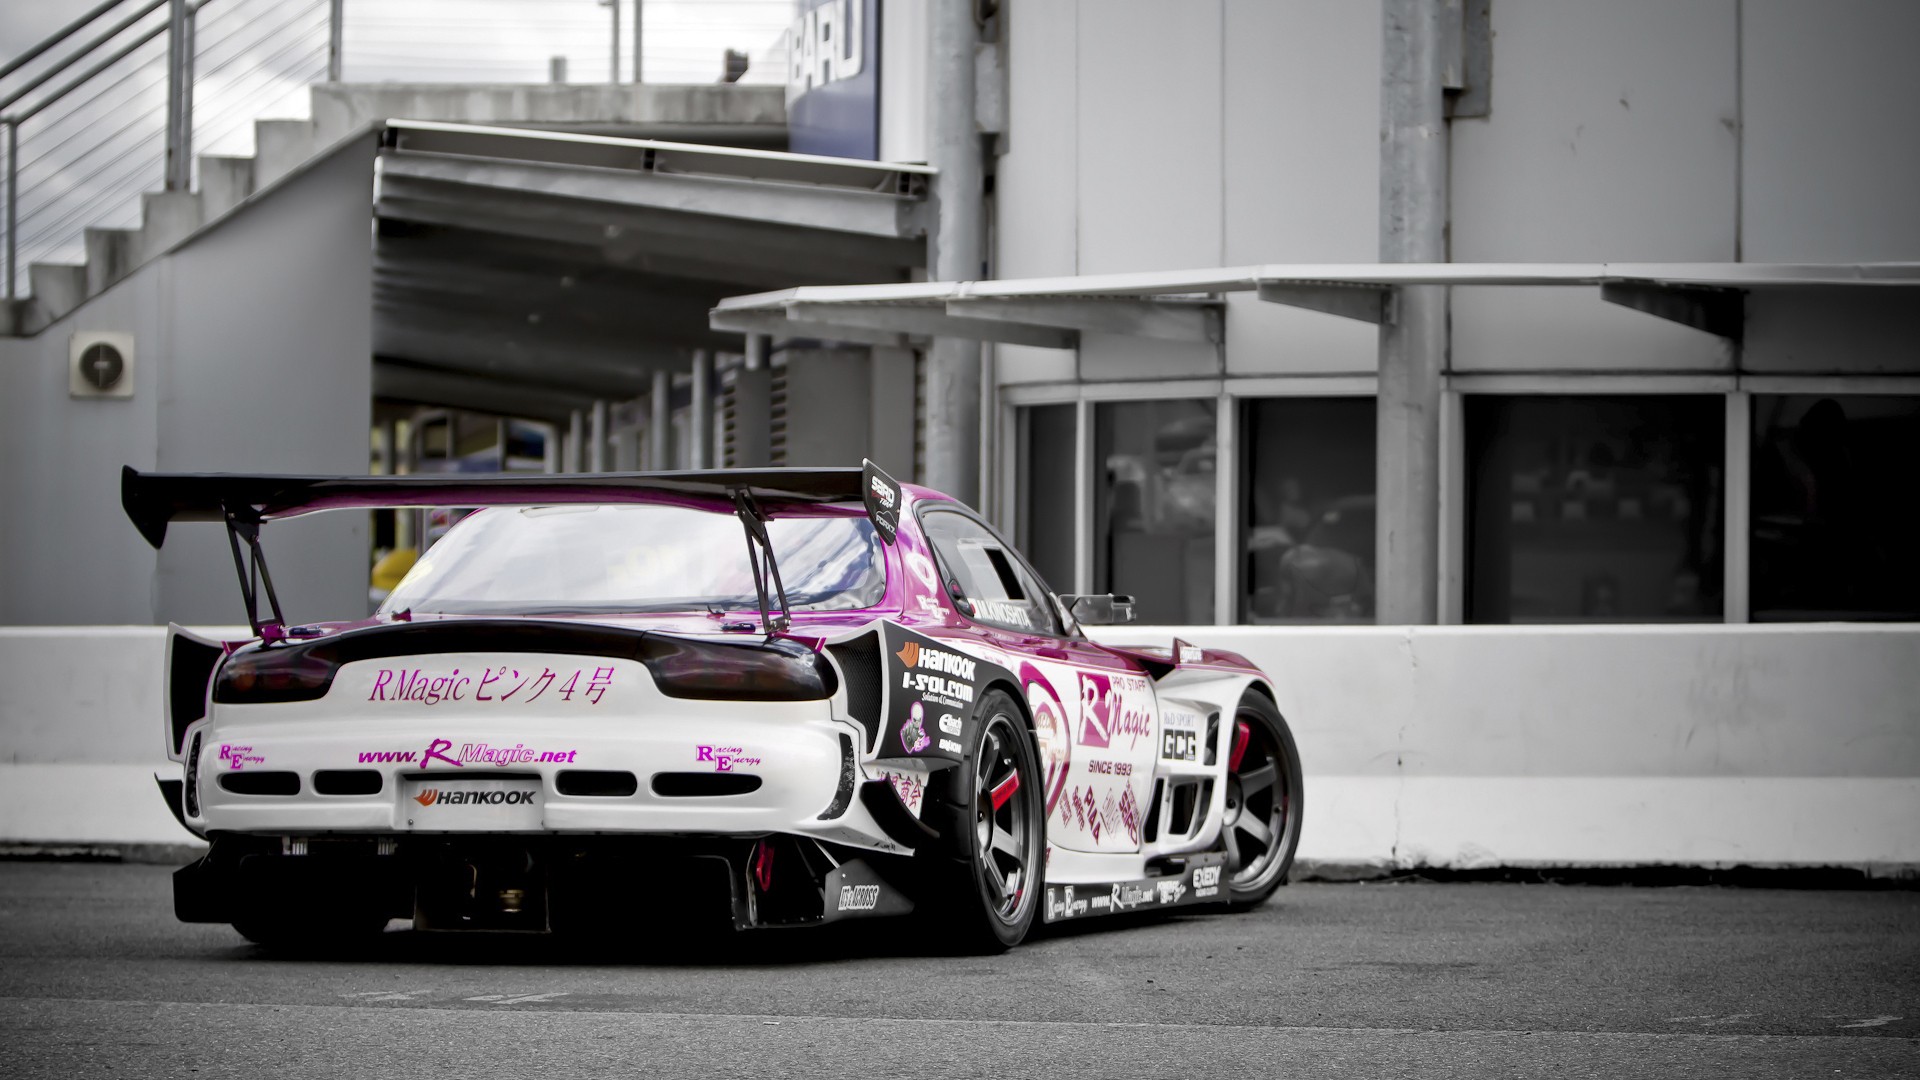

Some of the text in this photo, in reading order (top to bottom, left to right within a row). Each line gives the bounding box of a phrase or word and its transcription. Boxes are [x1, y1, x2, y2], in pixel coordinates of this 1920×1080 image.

[1088, 759, 1132, 776] SINCE 1993
[1193, 866, 1221, 888] EXEDY
